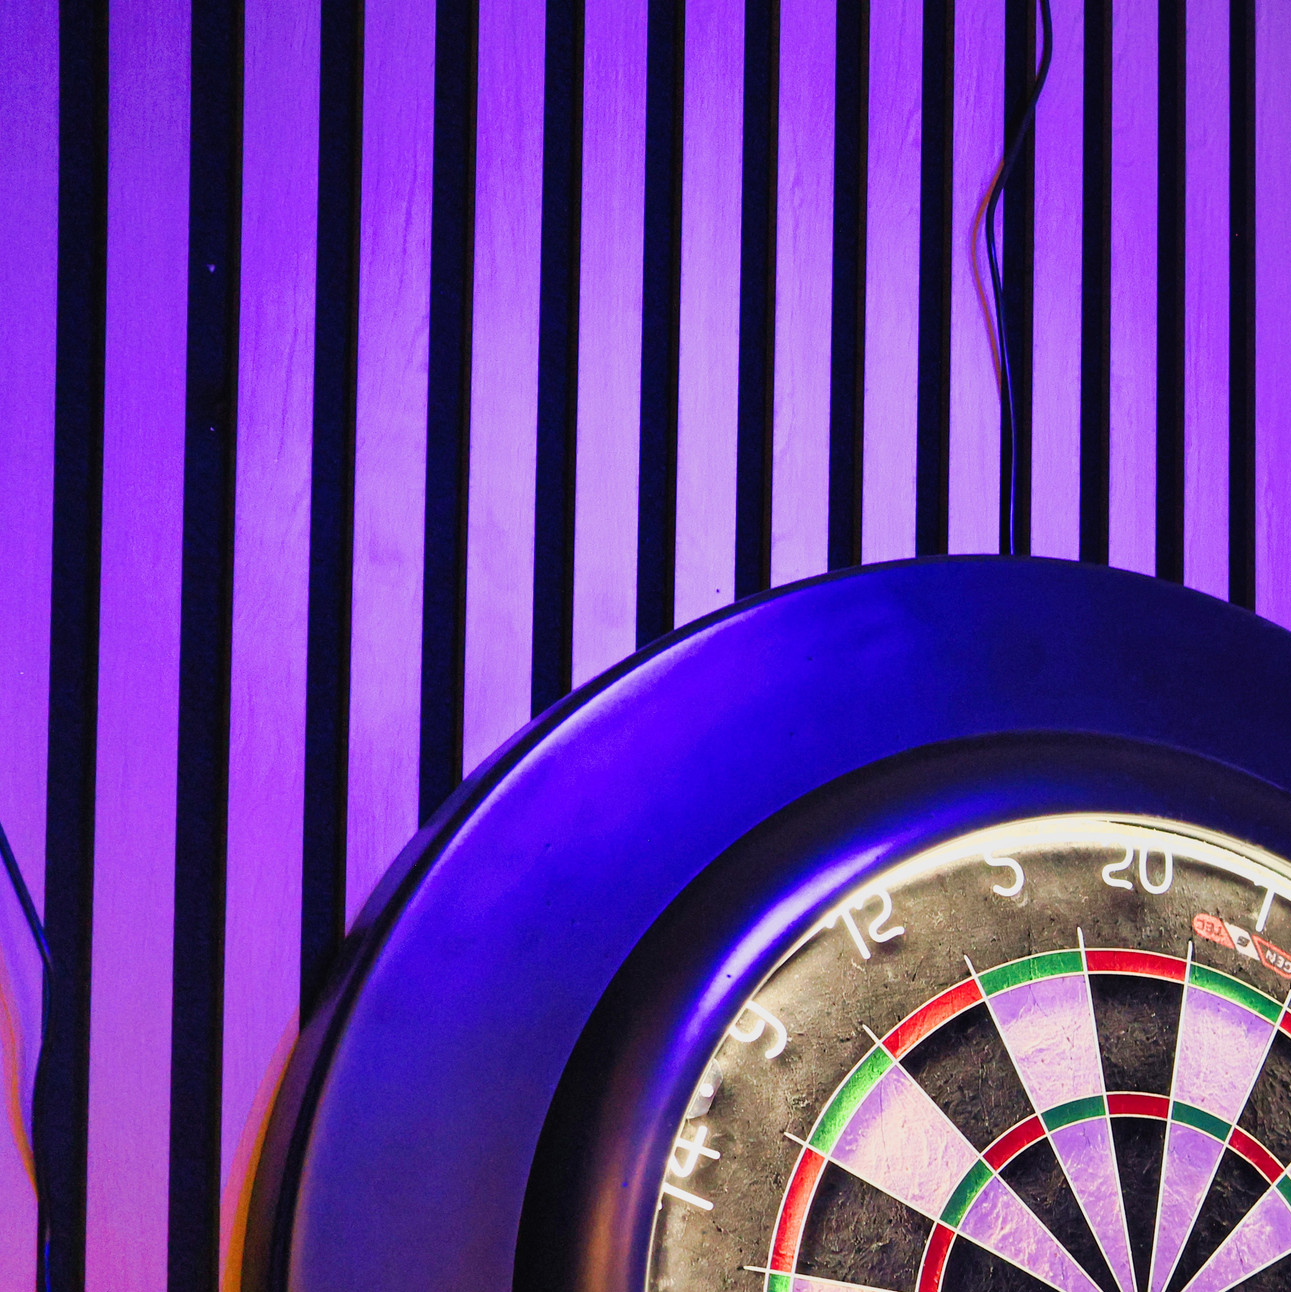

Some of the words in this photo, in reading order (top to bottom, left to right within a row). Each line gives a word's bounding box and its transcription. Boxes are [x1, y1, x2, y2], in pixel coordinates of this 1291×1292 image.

[1101, 841, 1174, 895] 20
[830, 884, 906, 960] 12
[658, 1125, 722, 1212] 14
